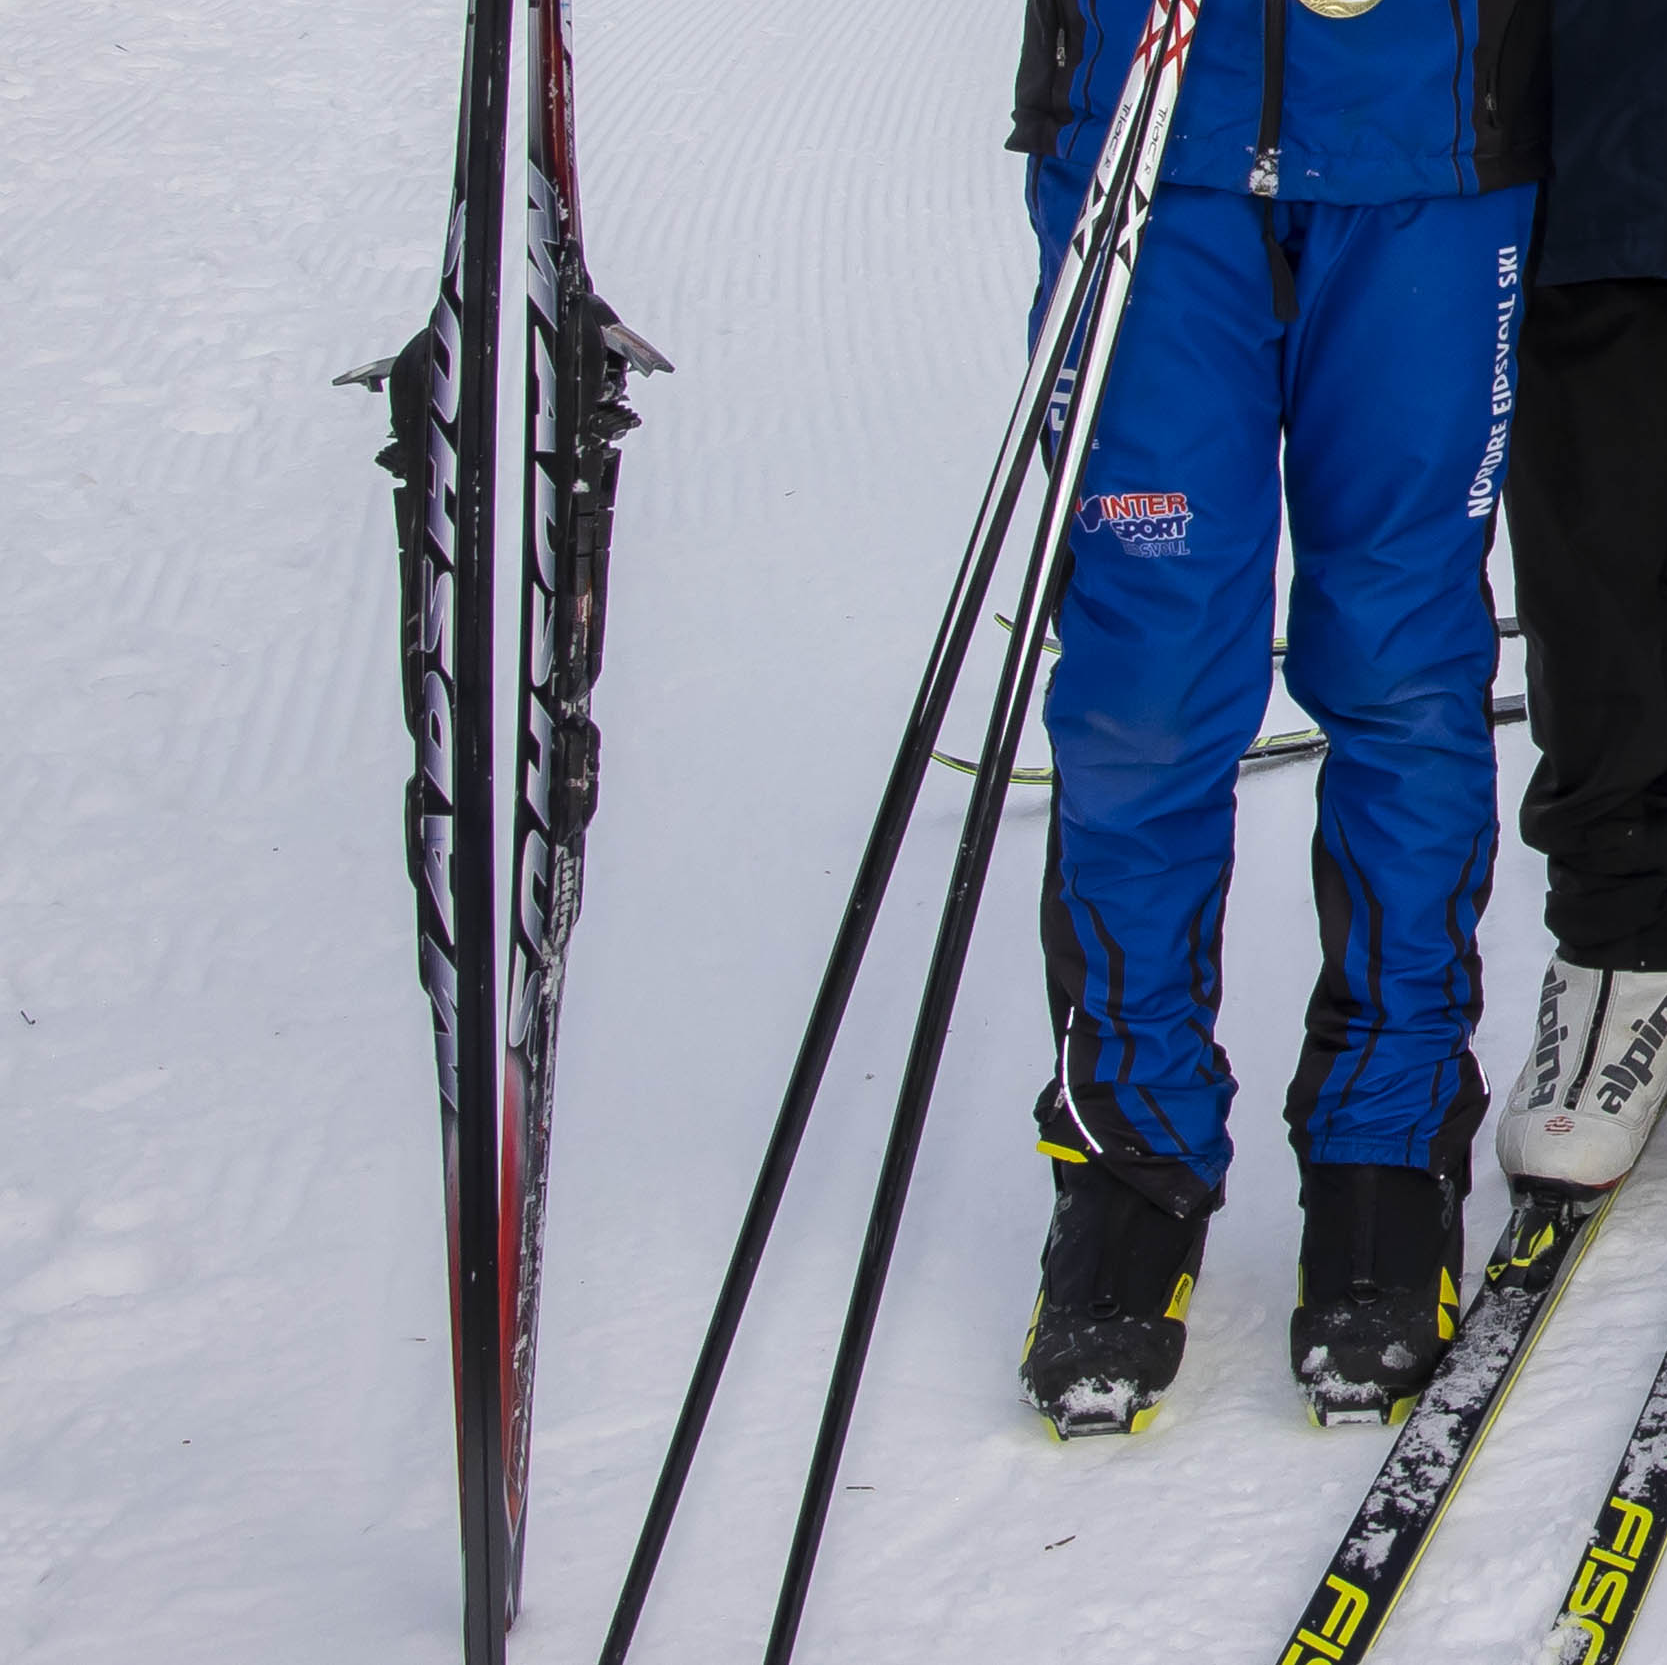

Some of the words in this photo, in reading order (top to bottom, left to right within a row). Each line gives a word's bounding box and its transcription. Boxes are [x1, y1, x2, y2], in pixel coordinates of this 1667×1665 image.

[1499, 245, 1518, 287] SKI
[1493, 292, 1517, 416] EIDSVOLL
[1468, 419, 1508, 519] NORDRE
[1101, 492, 1189, 519] INTER
[1112, 514, 1193, 541] SPORT
